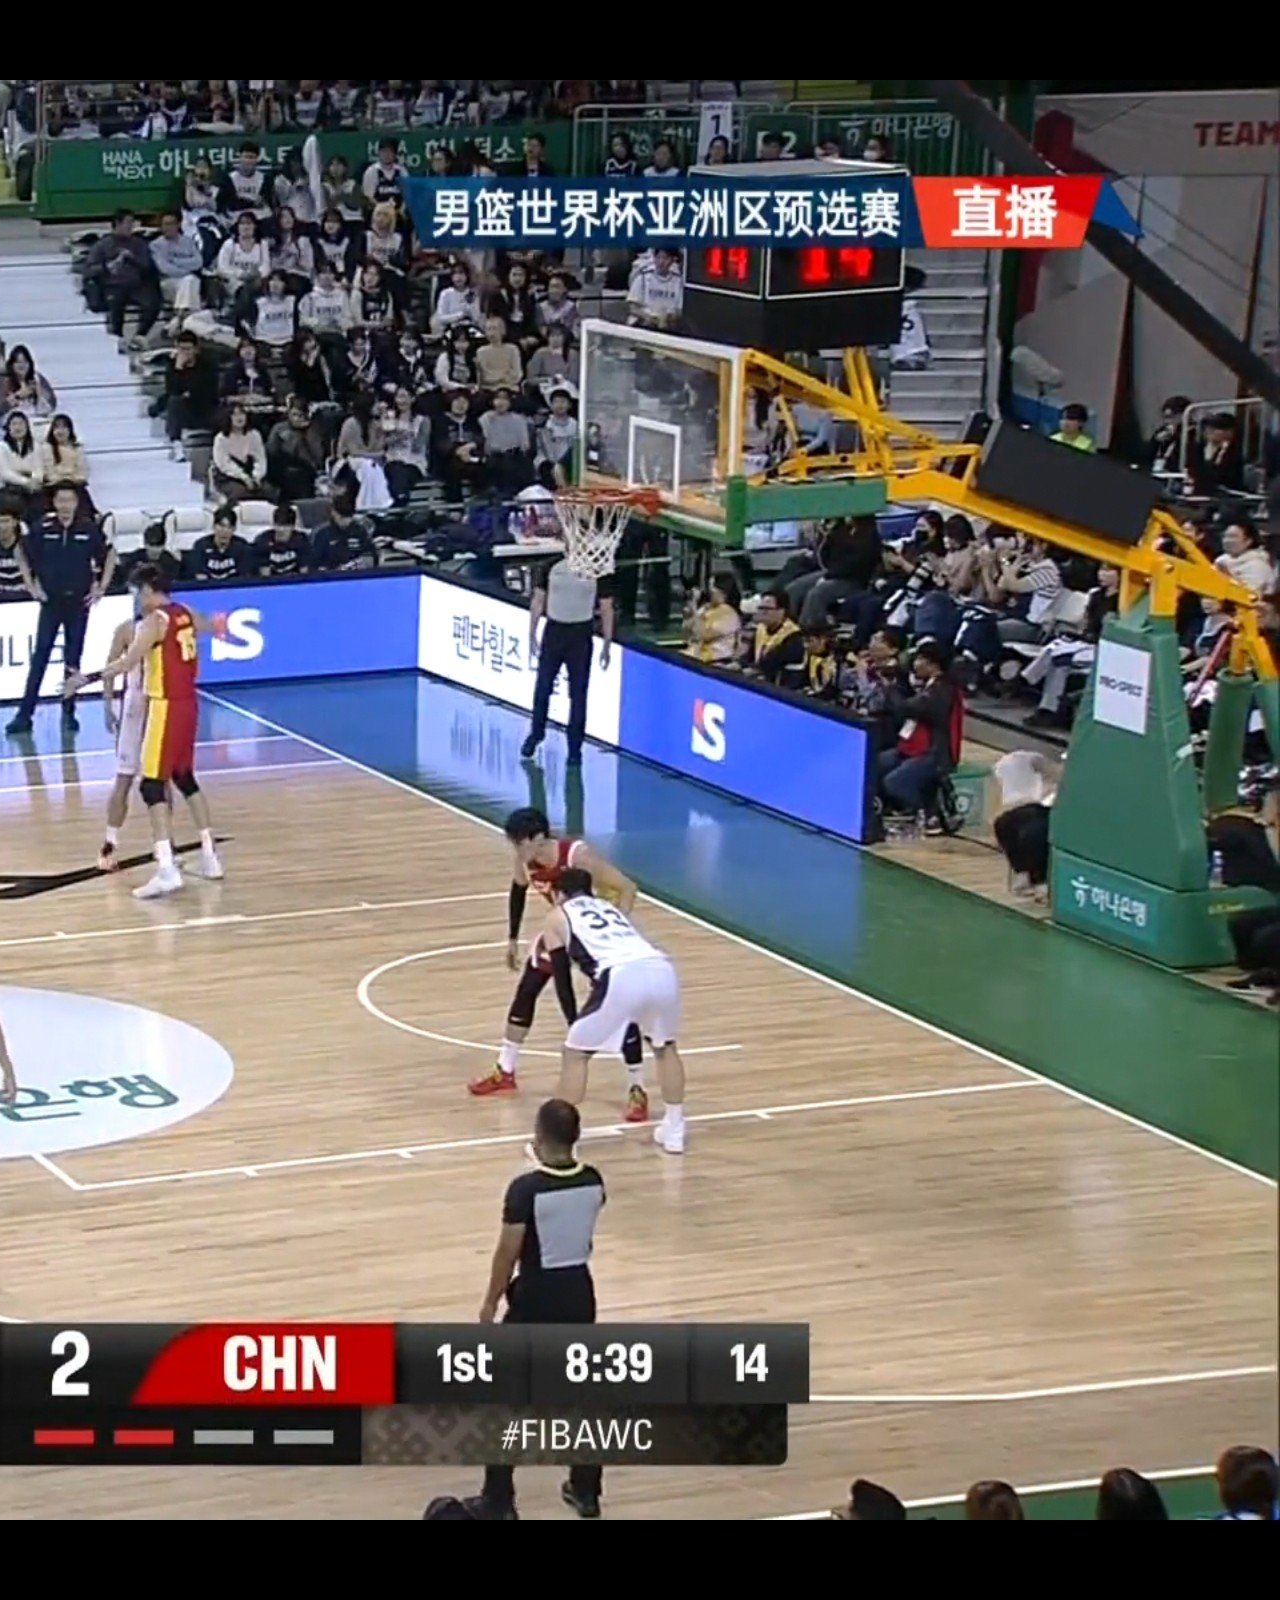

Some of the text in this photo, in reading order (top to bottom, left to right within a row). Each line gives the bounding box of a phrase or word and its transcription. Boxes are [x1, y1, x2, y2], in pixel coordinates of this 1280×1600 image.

[1194, 121, 1279, 148] TEAM
[102, 150, 144, 166] HANA
[116, 164, 156, 180] NEXT
[452, 615, 523, 673] 펜타힐즈
[1091, 887, 1147, 927] 하나은행
